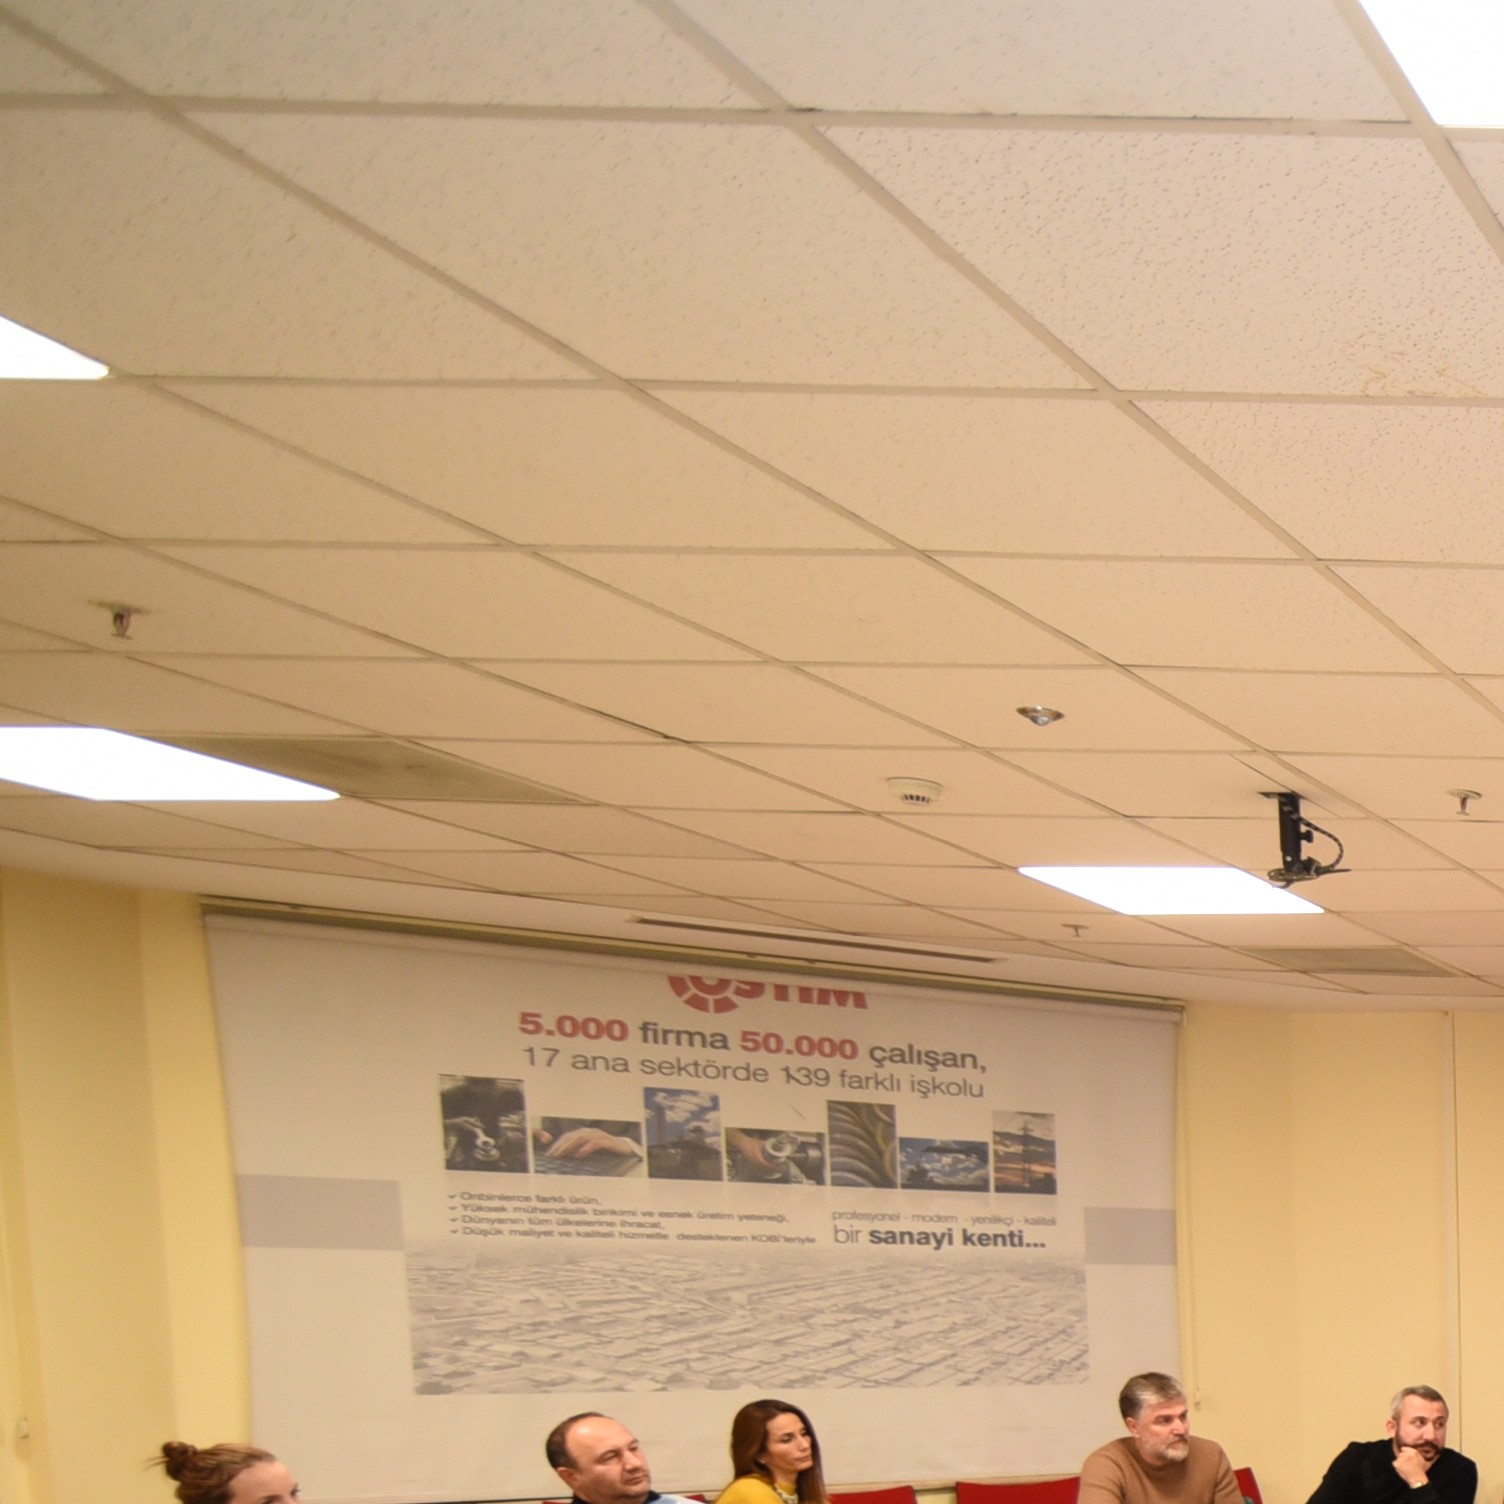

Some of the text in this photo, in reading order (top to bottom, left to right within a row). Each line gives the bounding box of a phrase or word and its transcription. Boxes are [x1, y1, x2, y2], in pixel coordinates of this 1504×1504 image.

[519, 1011, 988, 1075] 5.000 firma 50.000 çalışan,
[521, 1046, 985, 1099] 17 ana sektörde 139 farklı işkolu
[833, 1224, 1047, 1251] bir sanayi kenti...
